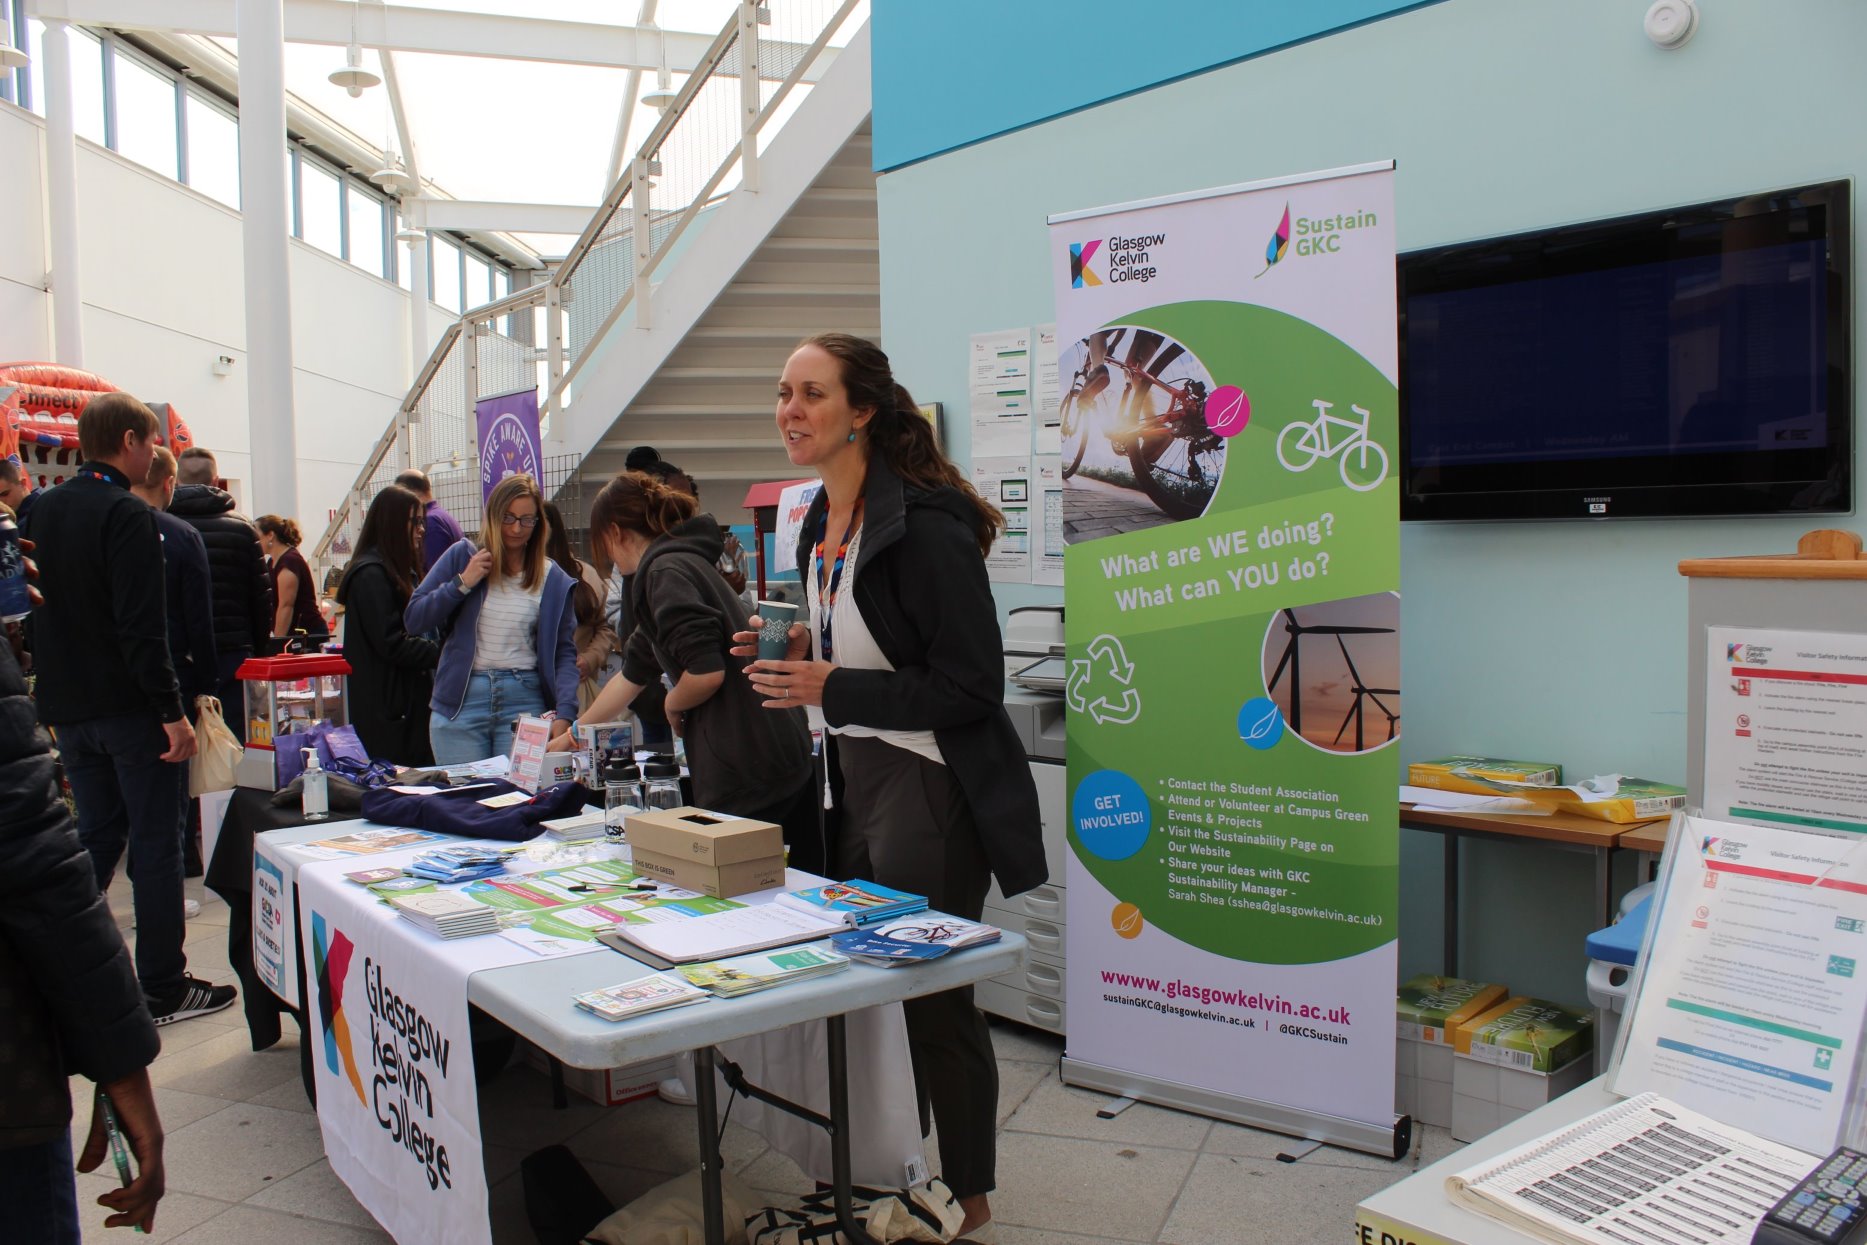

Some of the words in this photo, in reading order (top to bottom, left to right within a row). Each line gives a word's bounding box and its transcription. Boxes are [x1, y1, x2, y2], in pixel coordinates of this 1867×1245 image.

[1295, 210, 1377, 234] Sustain
[1108, 232, 1165, 253] Glasgow
[1295, 234, 1341, 256] GKC
[1109, 251, 1149, 267] Kelvin
[1109, 266, 1157, 284] College
[483, 433, 500, 484] SPIKE
[500, 422, 526, 456] AWARE
[1100, 551, 1159, 579] What
[1167, 547, 1201, 568] are
[1207, 530, 1249, 558] WE
[1257, 512, 1335, 550] doing?
[1114, 584, 1174, 612] What
[1181, 578, 1220, 601] can
[1226, 562, 1279, 592] YOU
[1287, 552, 1330, 581] do?
[1818, 653, 1838, 661] Safety
[1094, 794, 1122, 811] GET
[1167, 777, 1207, 792] Contact
[1209, 781, 1227, 793] the
[1230, 781, 1272, 796] Student
[1275, 785, 1339, 803] Association
[1168, 793, 1201, 807] Attend
[1204, 798, 1216, 808] or
[1218, 797, 1270, 813] Volunteer
[1274, 803, 1285, 814] at
[1287, 803, 1332, 819] Campus
[1334, 807, 1369, 823] Green
[1168, 809, 1202, 823] Events
[1206, 813, 1214, 824] &
[1217, 813, 1262, 829] Projects
[1080, 813, 1144, 830] INVOLVED!
[1168, 825, 1191, 839] Visit
[1194, 827, 1210, 840] the
[1213, 828, 1287, 849] Sustainability
[1290, 836, 1317, 852] Page
[1320, 842, 1334, 853] on
[1168, 841, 1186, 854] Our
[1189, 842, 1231, 858] Website
[634, 859, 645, 869] THIS
[645, 861, 655, 871] BOX
[654, 864, 660, 872] IS
[659, 865, 675, 877] GREEN
[1168, 856, 1198, 871] Share
[1200, 861, 1225, 875] your
[1227, 862, 1256, 877] ideas
[1259, 865, 1283, 880] with
[1286, 869, 1310, 884] GKC
[1791, 853, 1810, 863] Safety
[1168, 872, 1238, 893] Sustainability
[1241, 881, 1288, 899] Manager
[1168, 888, 1197, 903] Sarah
[1200, 892, 1225, 906] Shea
[1227, 895, 1383, 927] (sshea@glasgowkelvin.ac.uk)
[364, 957, 451, 1080] Glasgow
[1103, 993, 1255, 1029] sustainGKC@glasgowkelvin.ac.uk
[1279, 1023, 1349, 1045] @GKCSustain
[369, 1013, 434, 1118] Kelvin
[372, 1074, 451, 1192] College
